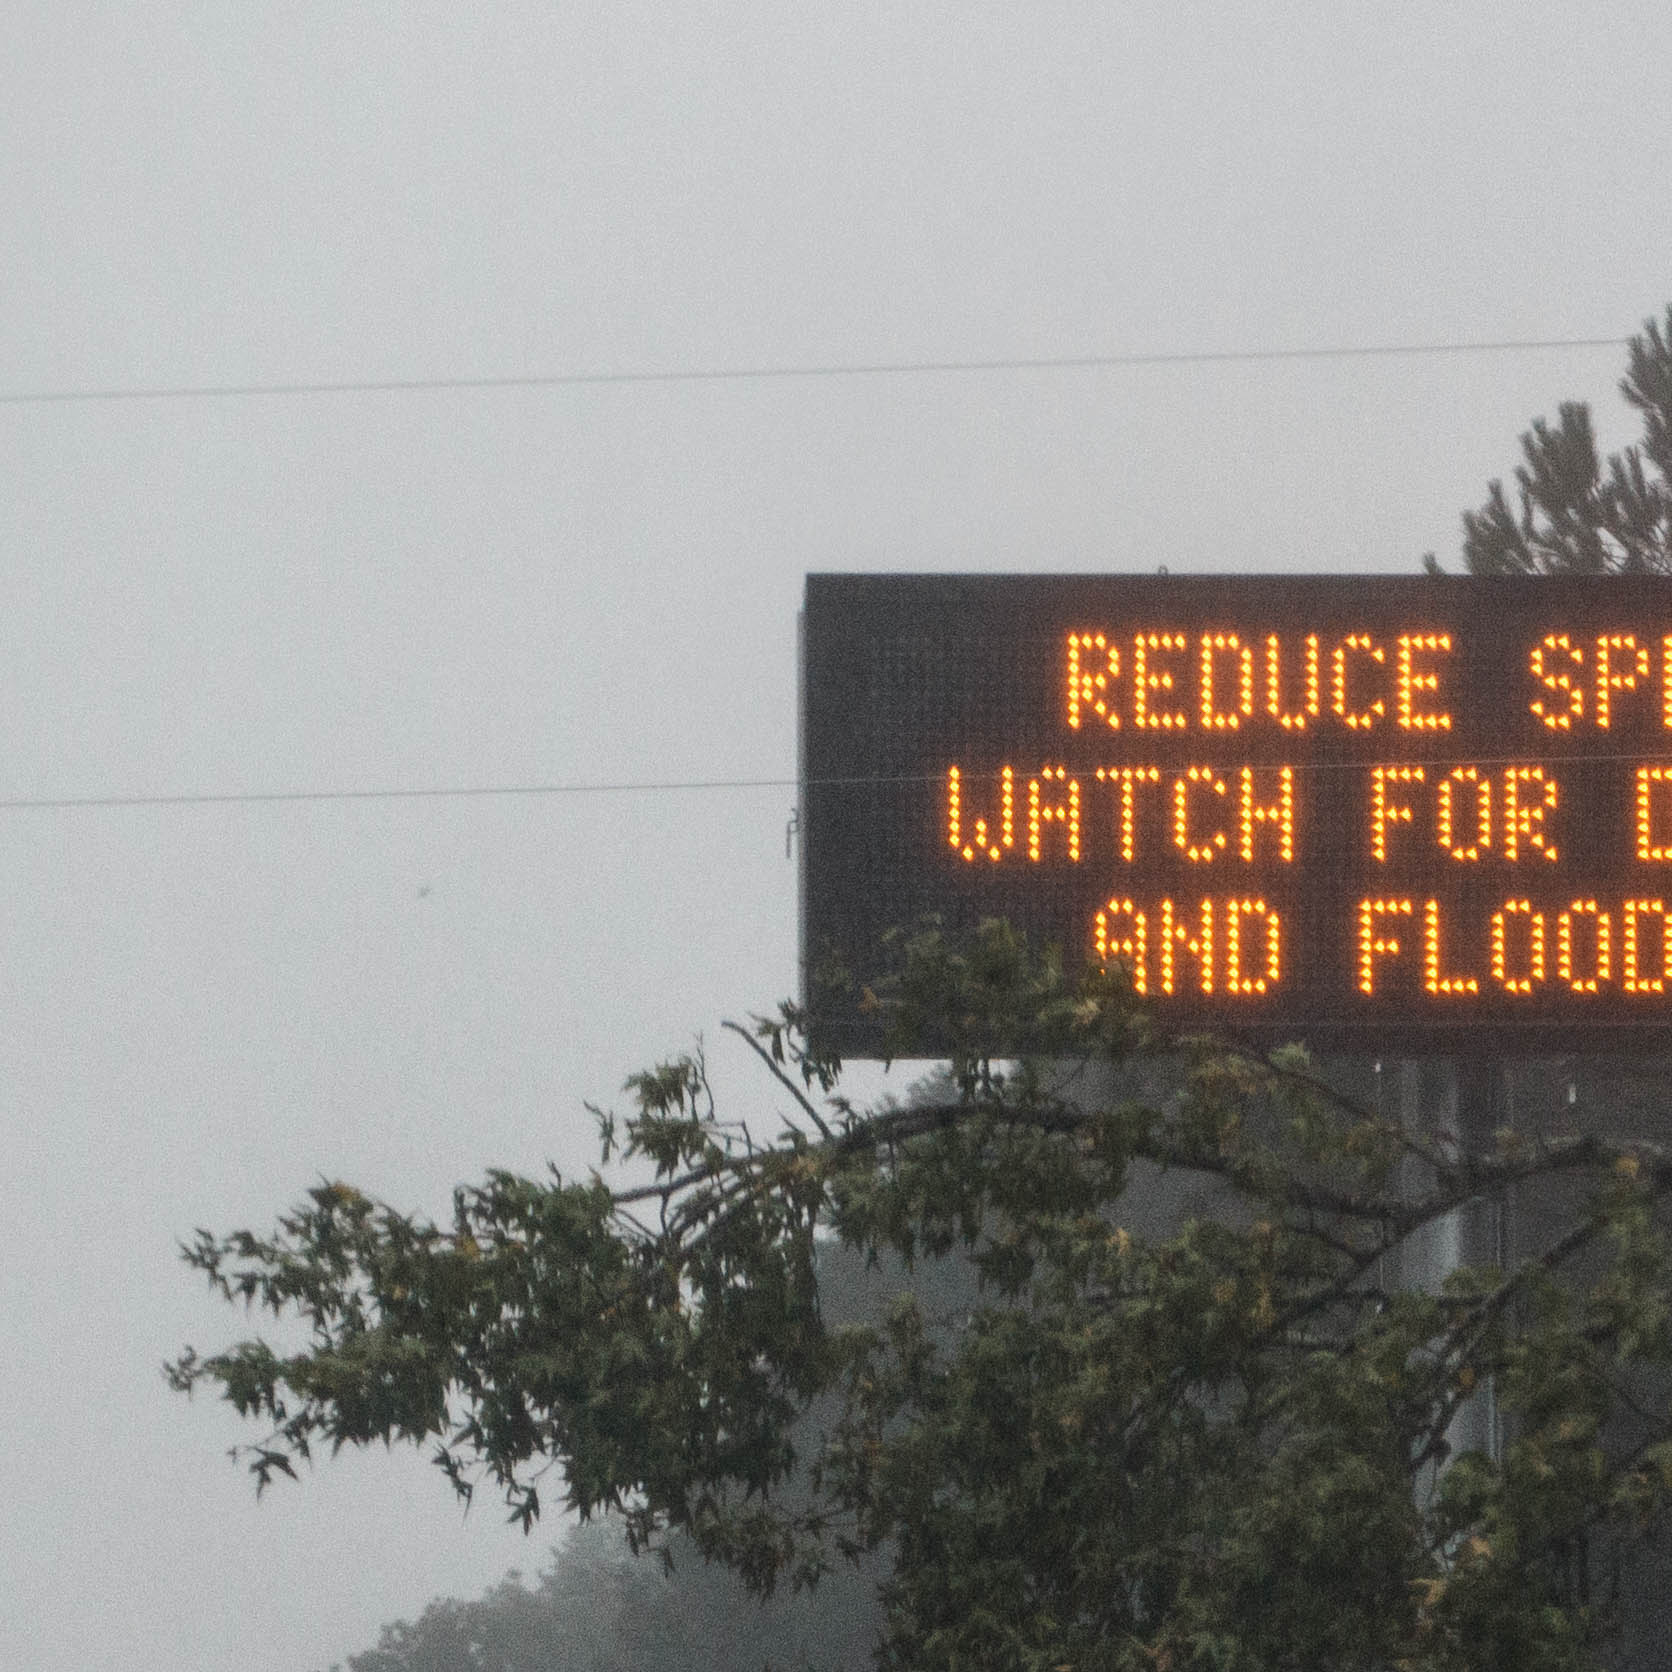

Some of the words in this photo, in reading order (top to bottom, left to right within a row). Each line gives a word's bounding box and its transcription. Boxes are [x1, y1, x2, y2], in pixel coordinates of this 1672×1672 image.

[1064, 630, 1453, 733] REDUCE
[945, 764, 1296, 863] WATCH
[1369, 764, 1560, 863] FOR
[1092, 895, 1282, 996] AND
